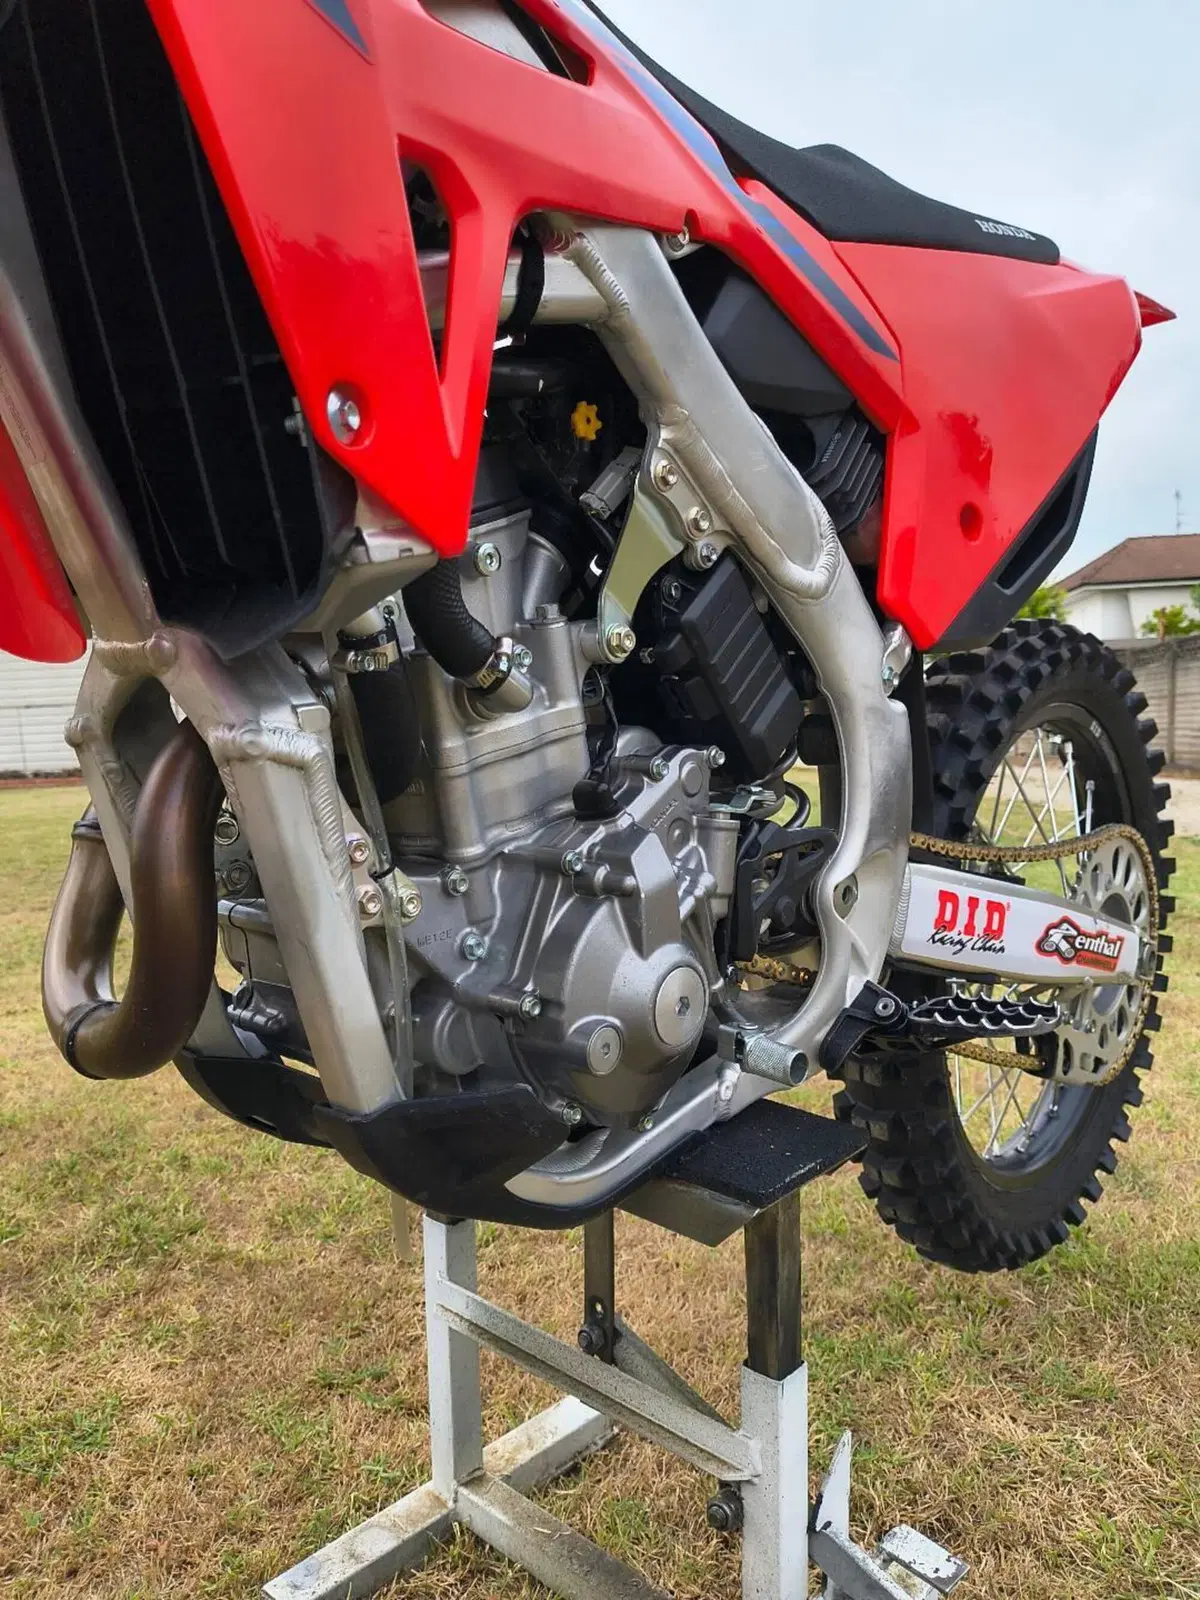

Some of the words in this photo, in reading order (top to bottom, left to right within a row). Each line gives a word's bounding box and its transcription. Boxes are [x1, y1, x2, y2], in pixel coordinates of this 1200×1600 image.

[974, 219, 1037, 241] HONDA
[926, 924, 974, 956] Racing
[970, 932, 1006, 955] Chain
